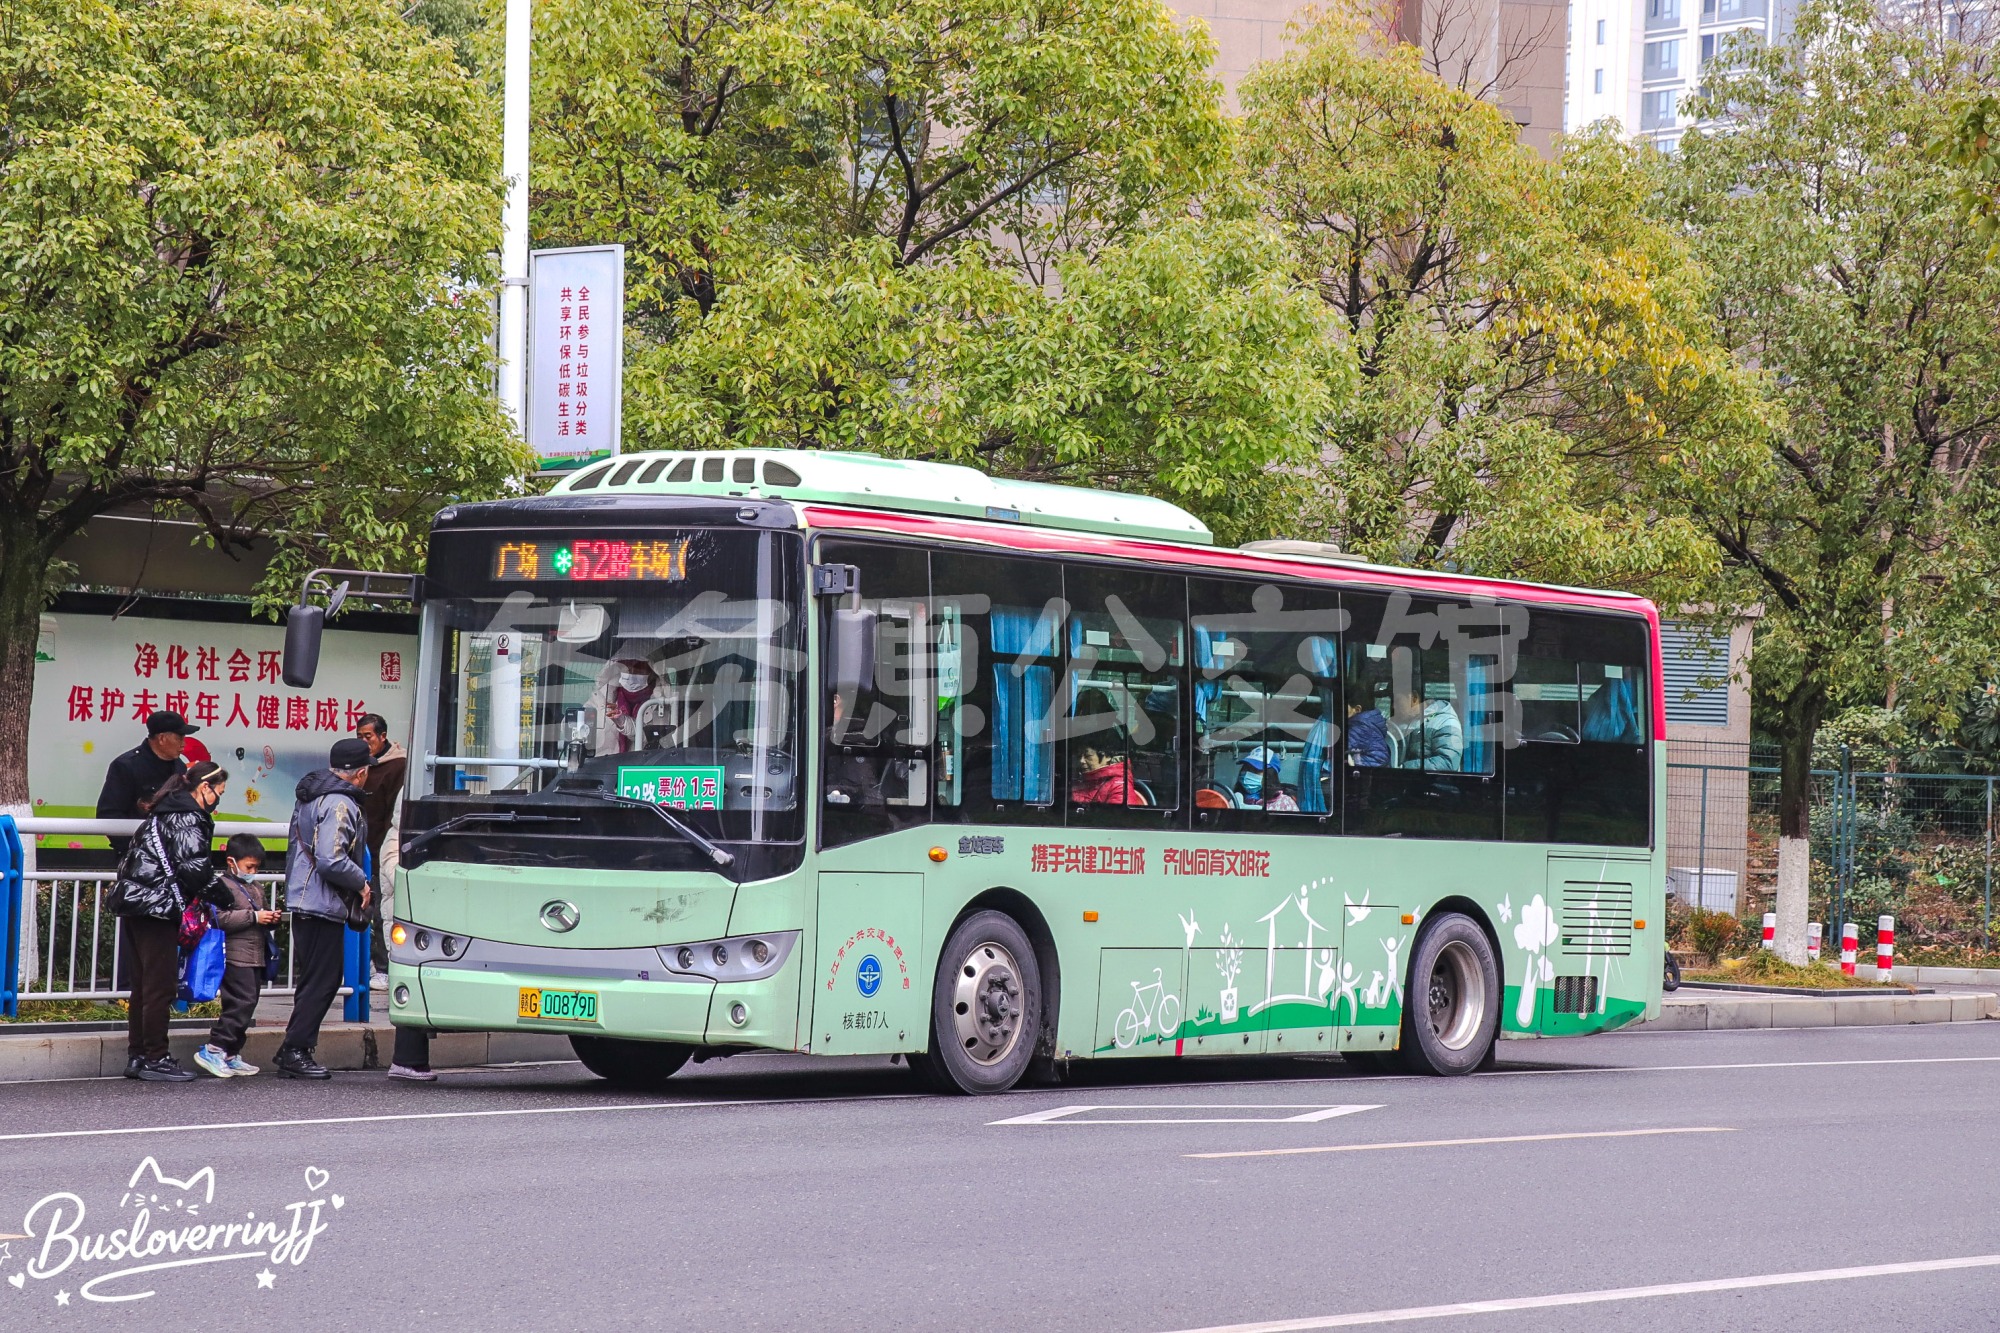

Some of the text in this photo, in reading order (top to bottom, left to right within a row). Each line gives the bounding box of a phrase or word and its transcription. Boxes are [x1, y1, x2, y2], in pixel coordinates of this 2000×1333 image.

[557, 287, 572, 436] 共享环保低碳生活
[576, 286, 590, 435] 全民参与垃圾分类
[497, 543, 539, 580] 广场
[571, 541, 631, 580] 52路
[133, 643, 282, 684] 净化社会环
[66, 685, 369, 733] 保护未成年人健康成长
[1031, 844, 1271, 877] 携手共建卫生城 齐心同育文明花
[842, 1010, 889, 1030] 核载67人
